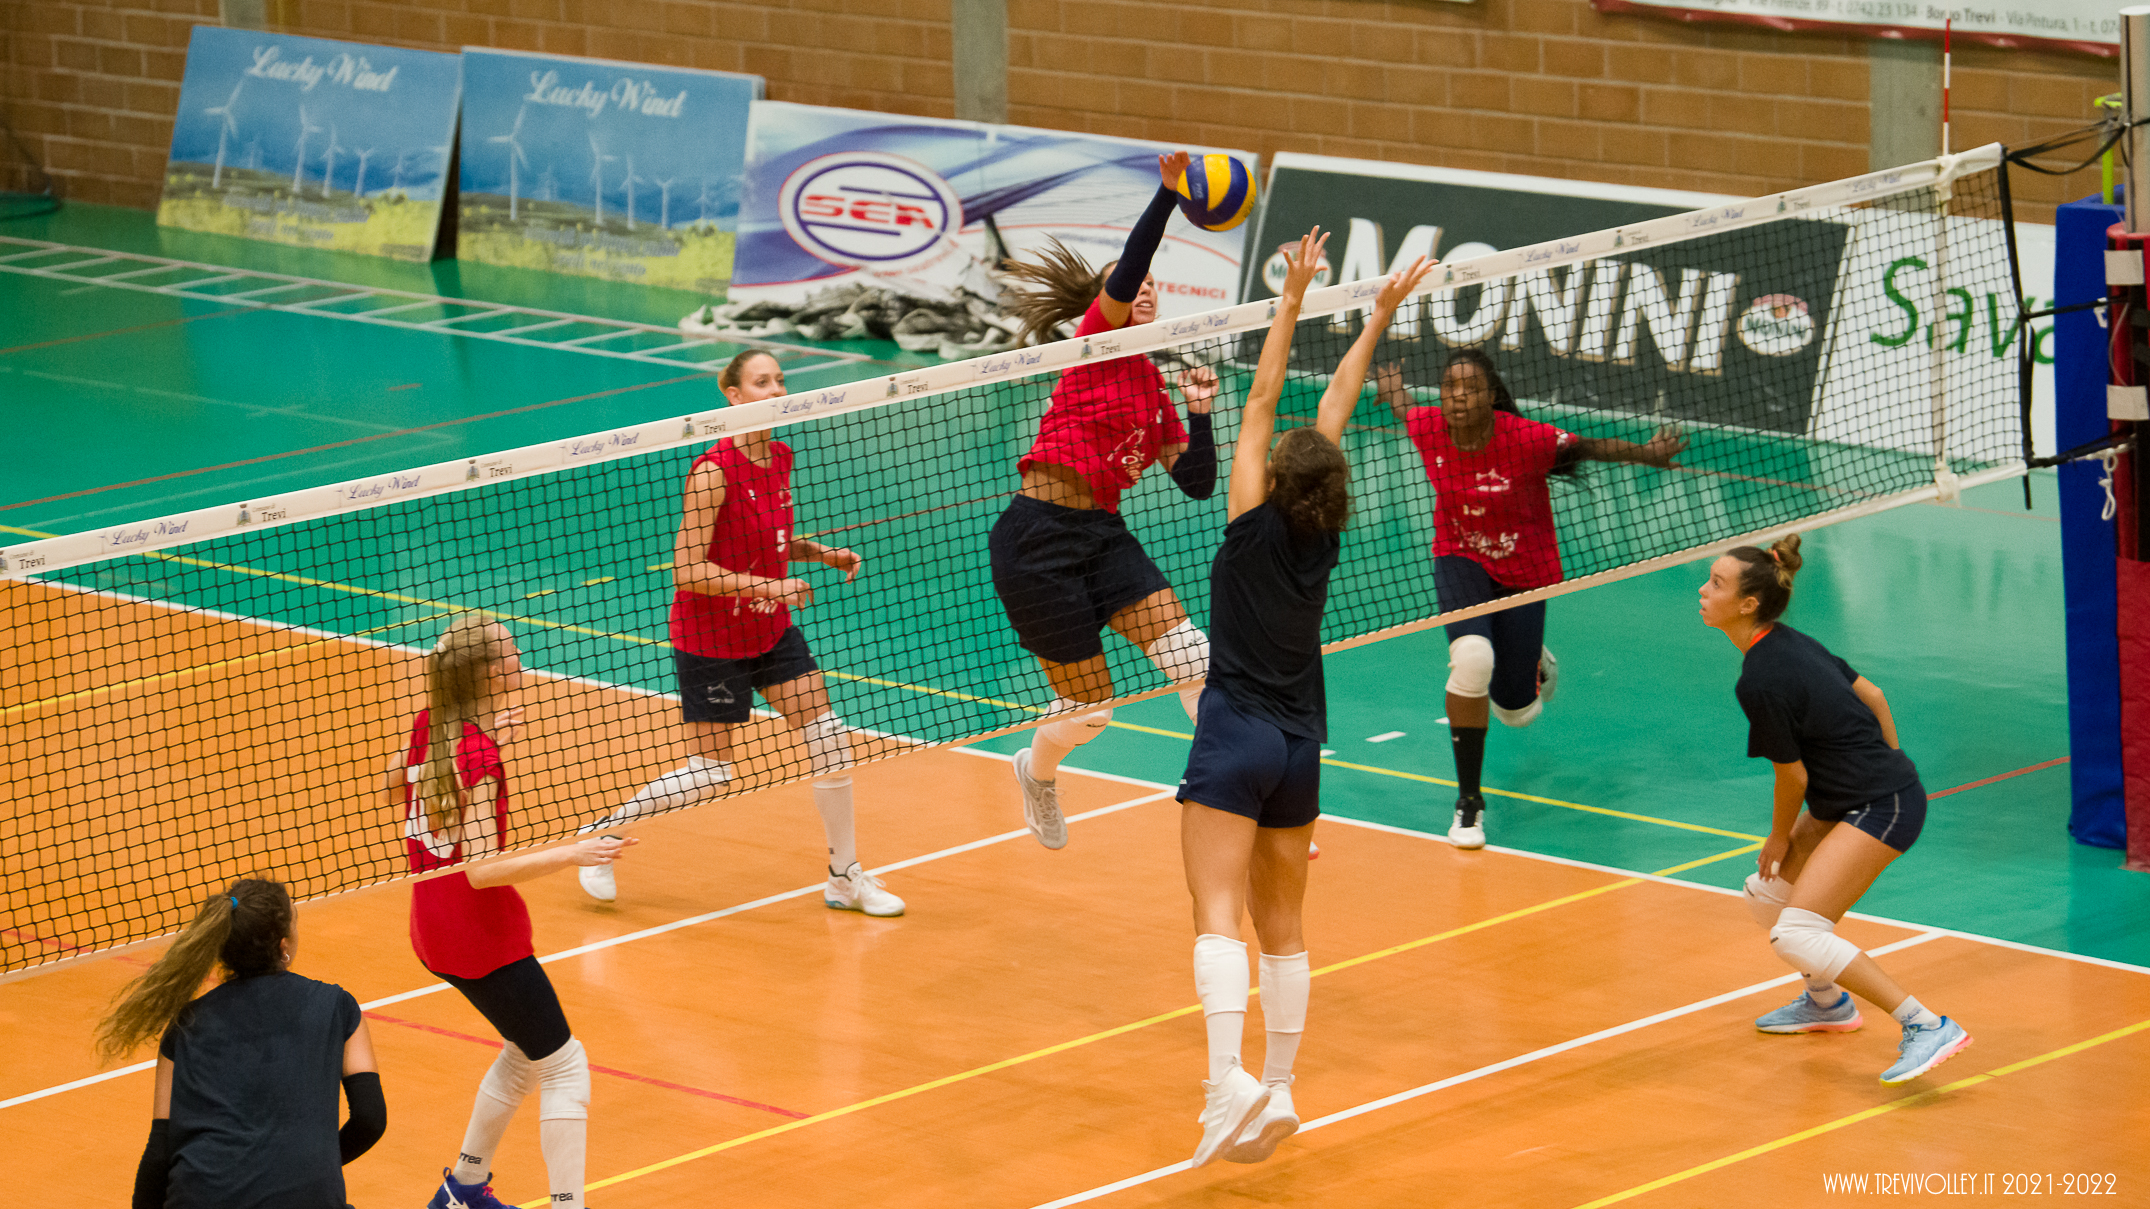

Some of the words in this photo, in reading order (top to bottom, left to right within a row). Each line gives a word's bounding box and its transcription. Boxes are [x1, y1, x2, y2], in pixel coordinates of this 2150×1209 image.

[1963, 7, 1996, 23] Trevi
[245, 46, 325, 92] Lucky
[326, 53, 398, 92] Wind
[523, 70, 609, 119] Lucky
[611, 78, 687, 117] Wind
[1156, 281, 1227, 299] TECNICI
[1328, 217, 1740, 376] MONINI
[1169, 322, 1200, 336] Lucky
[1202, 313, 1231, 327] Wind
[1101, 342, 1121, 355] Trevi
[981, 359, 1012, 374] Lucky
[1014, 352, 1043, 365] Wind
[908, 381, 929, 394] Trevi
[781, 398, 814, 414] Lucky
[816, 391, 847, 405] Wind
[704, 421, 726, 435] Trevi
[571, 440, 605, 455] Lucky
[608, 432, 640, 447] Wind
[489, 463, 513, 478] Trevi
[347, 482, 384, 500] Lucky
[387, 475, 421, 490] Wind
[261, 507, 286, 522] Trevi
[110, 528, 150, 547] Lucky
[153, 519, 189, 536] Wind
[776, 529, 786, 553] 5
[19, 554, 46, 570] Trevi
